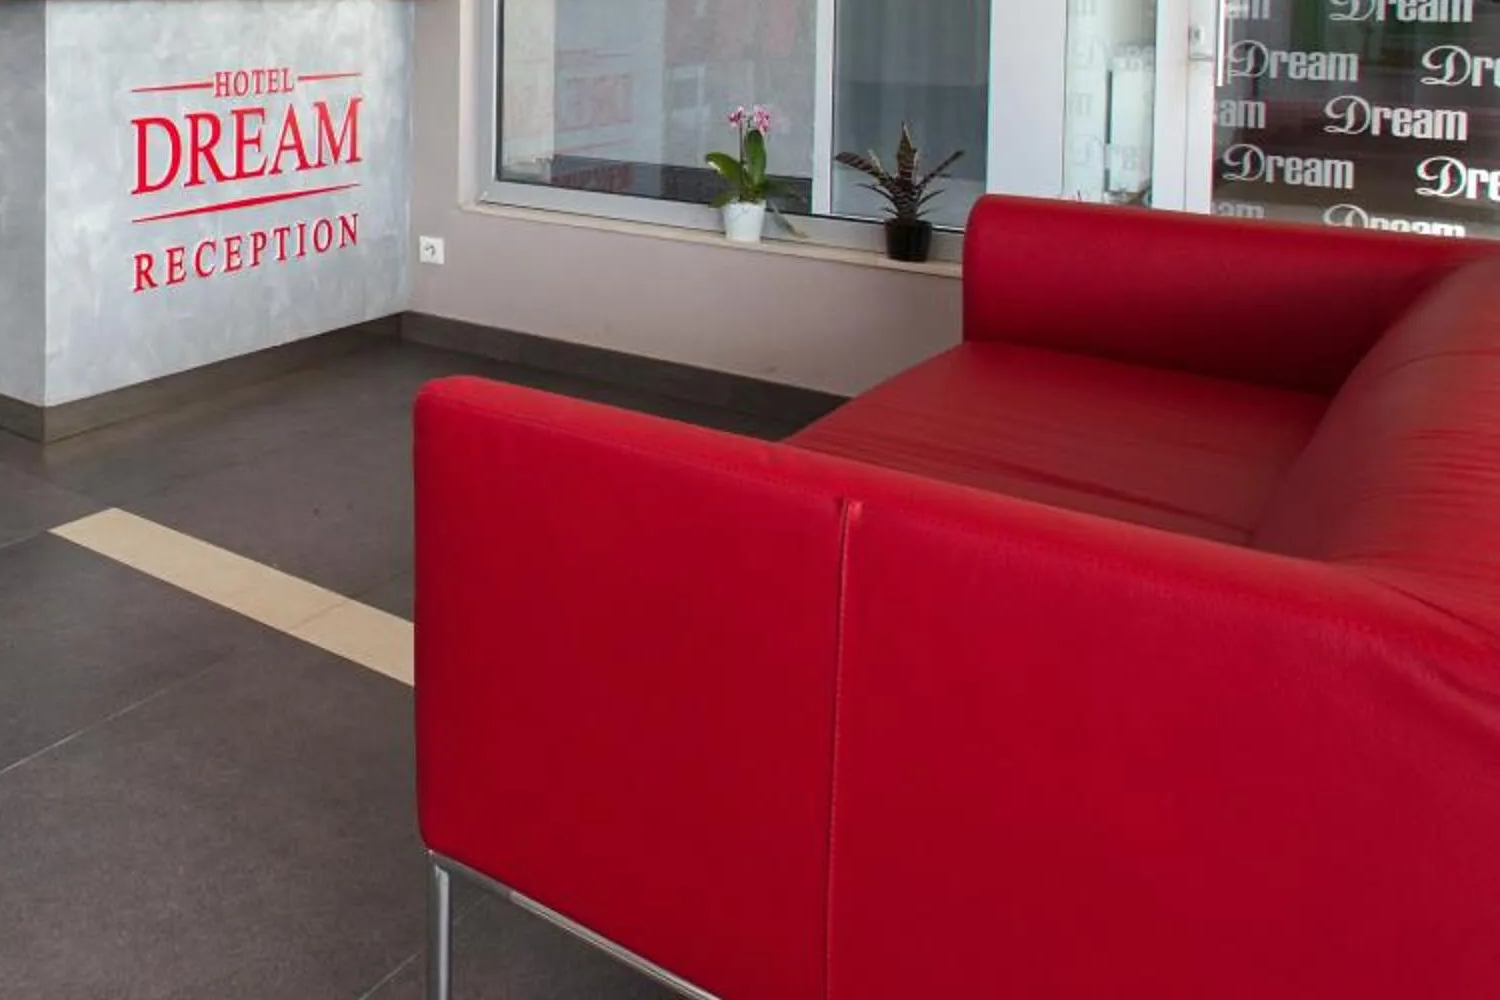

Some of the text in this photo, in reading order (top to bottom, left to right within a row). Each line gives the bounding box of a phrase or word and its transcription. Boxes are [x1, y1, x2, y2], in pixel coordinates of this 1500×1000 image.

[213, 68, 295, 97] HOTEL
[1229, 40, 1359, 82] Dream
[1323, 95, 1468, 141] Dream
[131, 97, 362, 195] DREAM
[1222, 143, 1354, 189] Dream
[133, 213, 359, 293] RECEPTION
